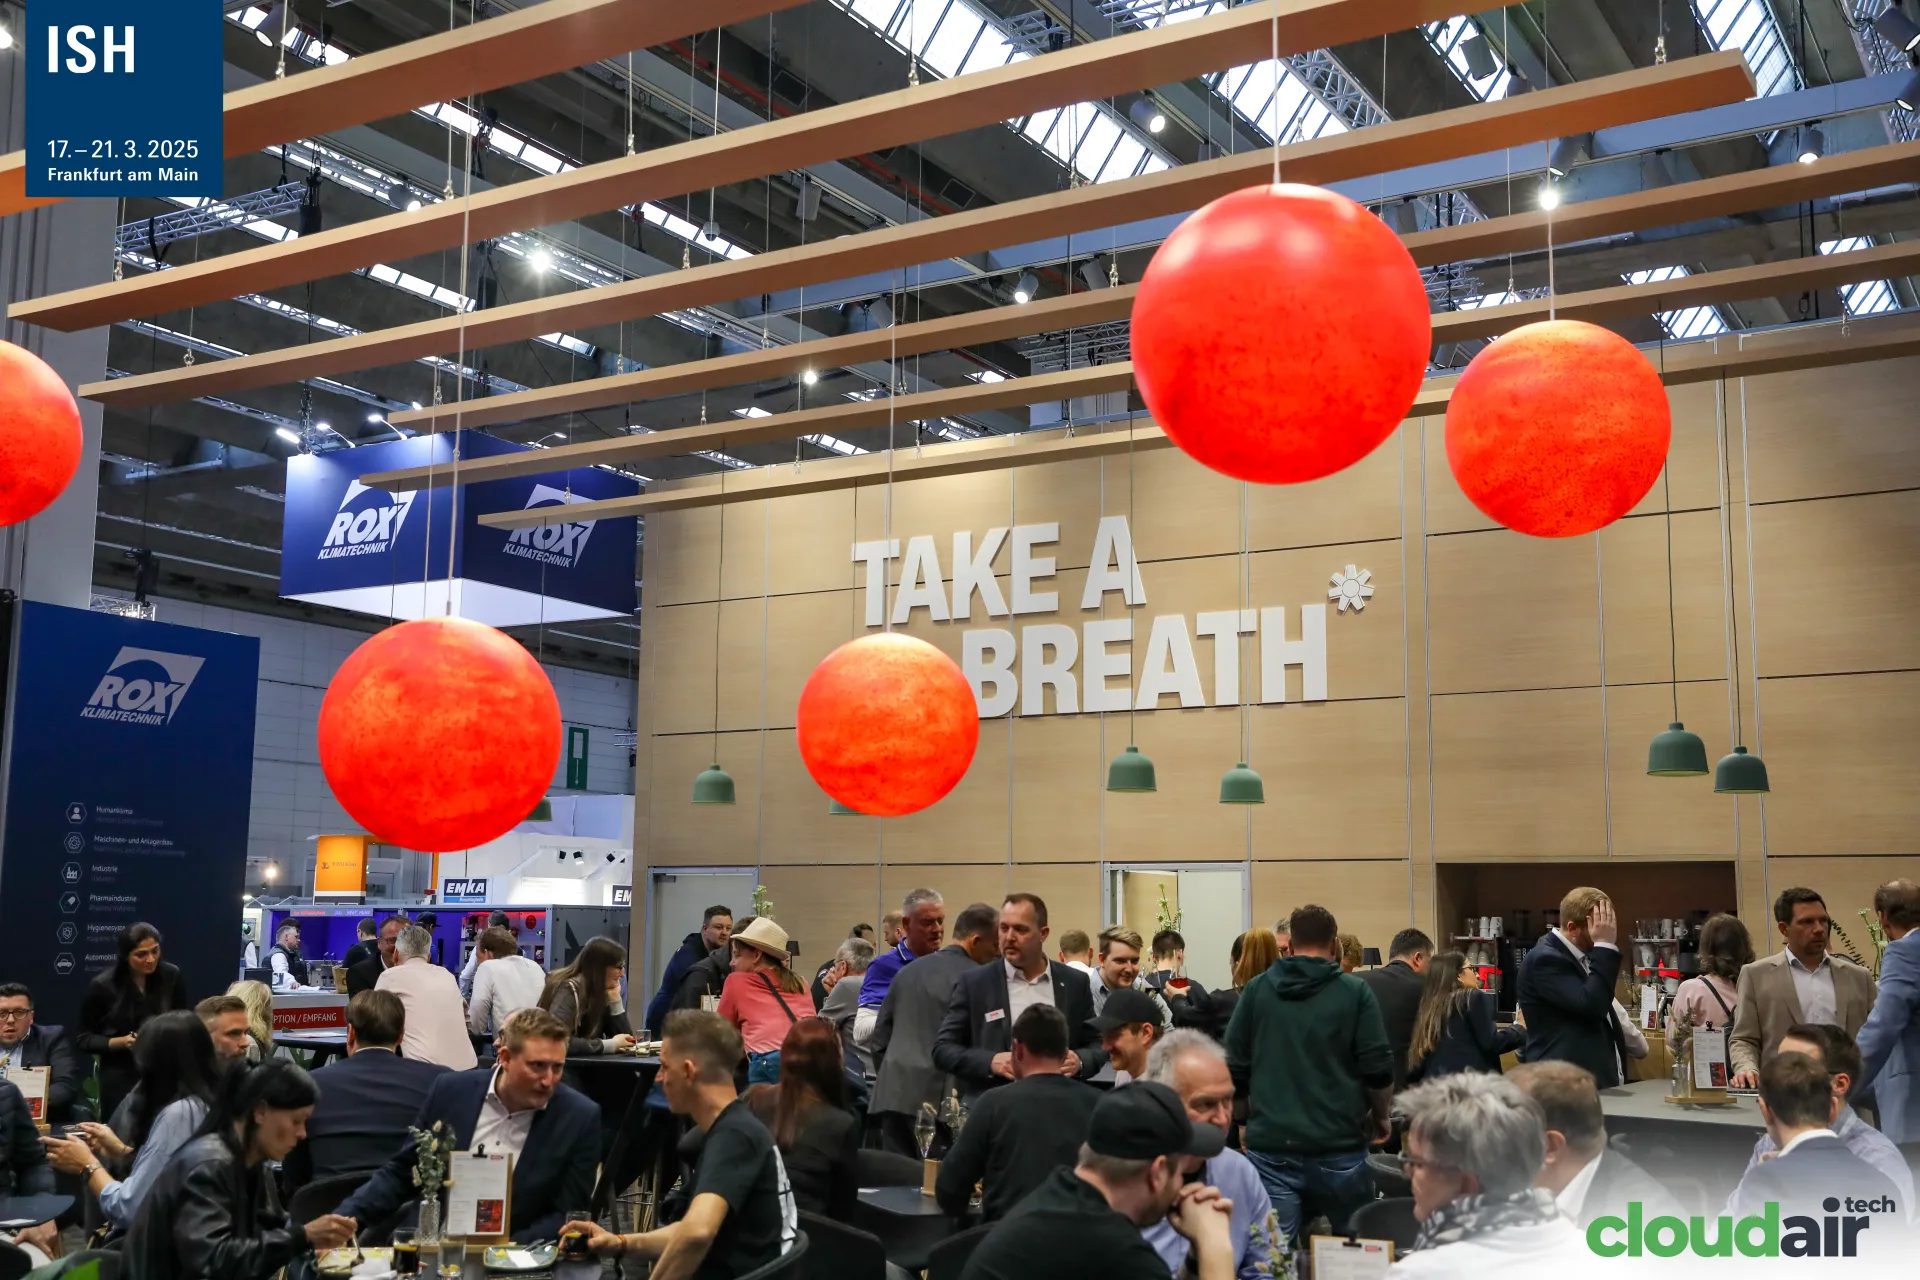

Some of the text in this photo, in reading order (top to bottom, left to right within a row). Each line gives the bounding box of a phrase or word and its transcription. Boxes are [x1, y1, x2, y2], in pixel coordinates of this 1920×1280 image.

[323, 502, 403, 546] ROX
[317, 541, 389, 560] KLIMATECHNIK
[503, 543, 572, 568] KLIMATECHNIK
[852, 515, 1147, 626] TAKE A
[962, 603, 1328, 718] BREATH
[87, 674, 181, 713] ROX
[80, 707, 165, 725] KLIMATECHNIK
[92, 865, 118, 873] Industrie
[446, 879, 485, 897] EMKA
[90, 895, 137, 903] Pharmaindustrie
[302, 1013, 337, 1023] EMPFANG
